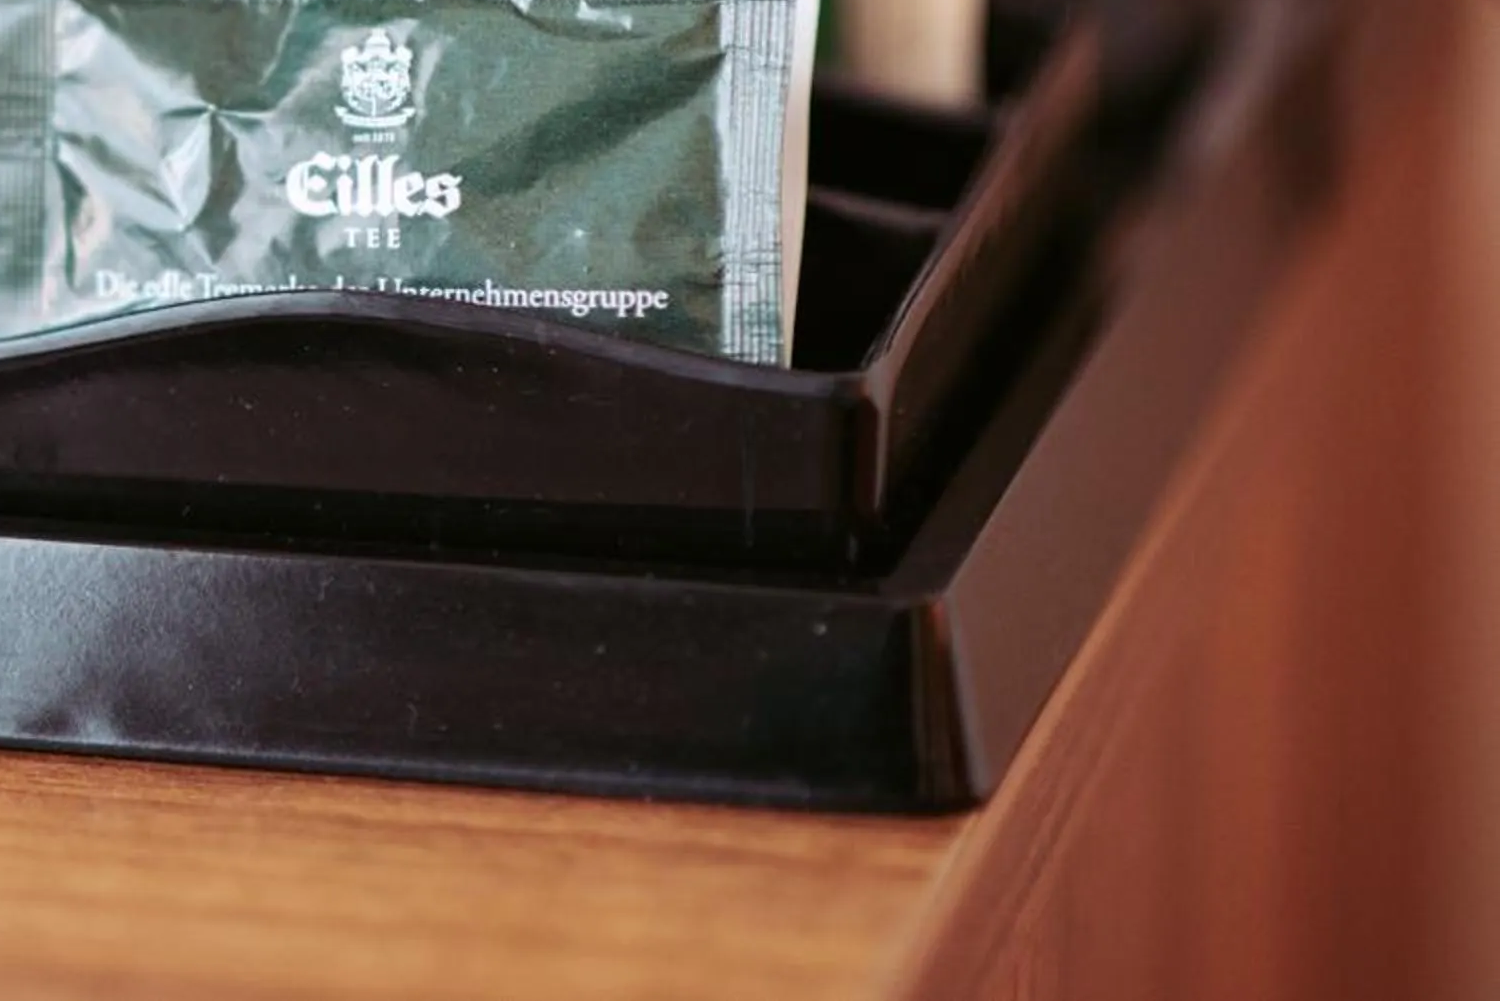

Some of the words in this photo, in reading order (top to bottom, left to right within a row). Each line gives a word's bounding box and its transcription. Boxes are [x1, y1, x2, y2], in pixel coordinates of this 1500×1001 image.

[286, 151, 463, 218] Eilles
[344, 227, 401, 249] TEE
[195, 273, 318, 299] Teemk
